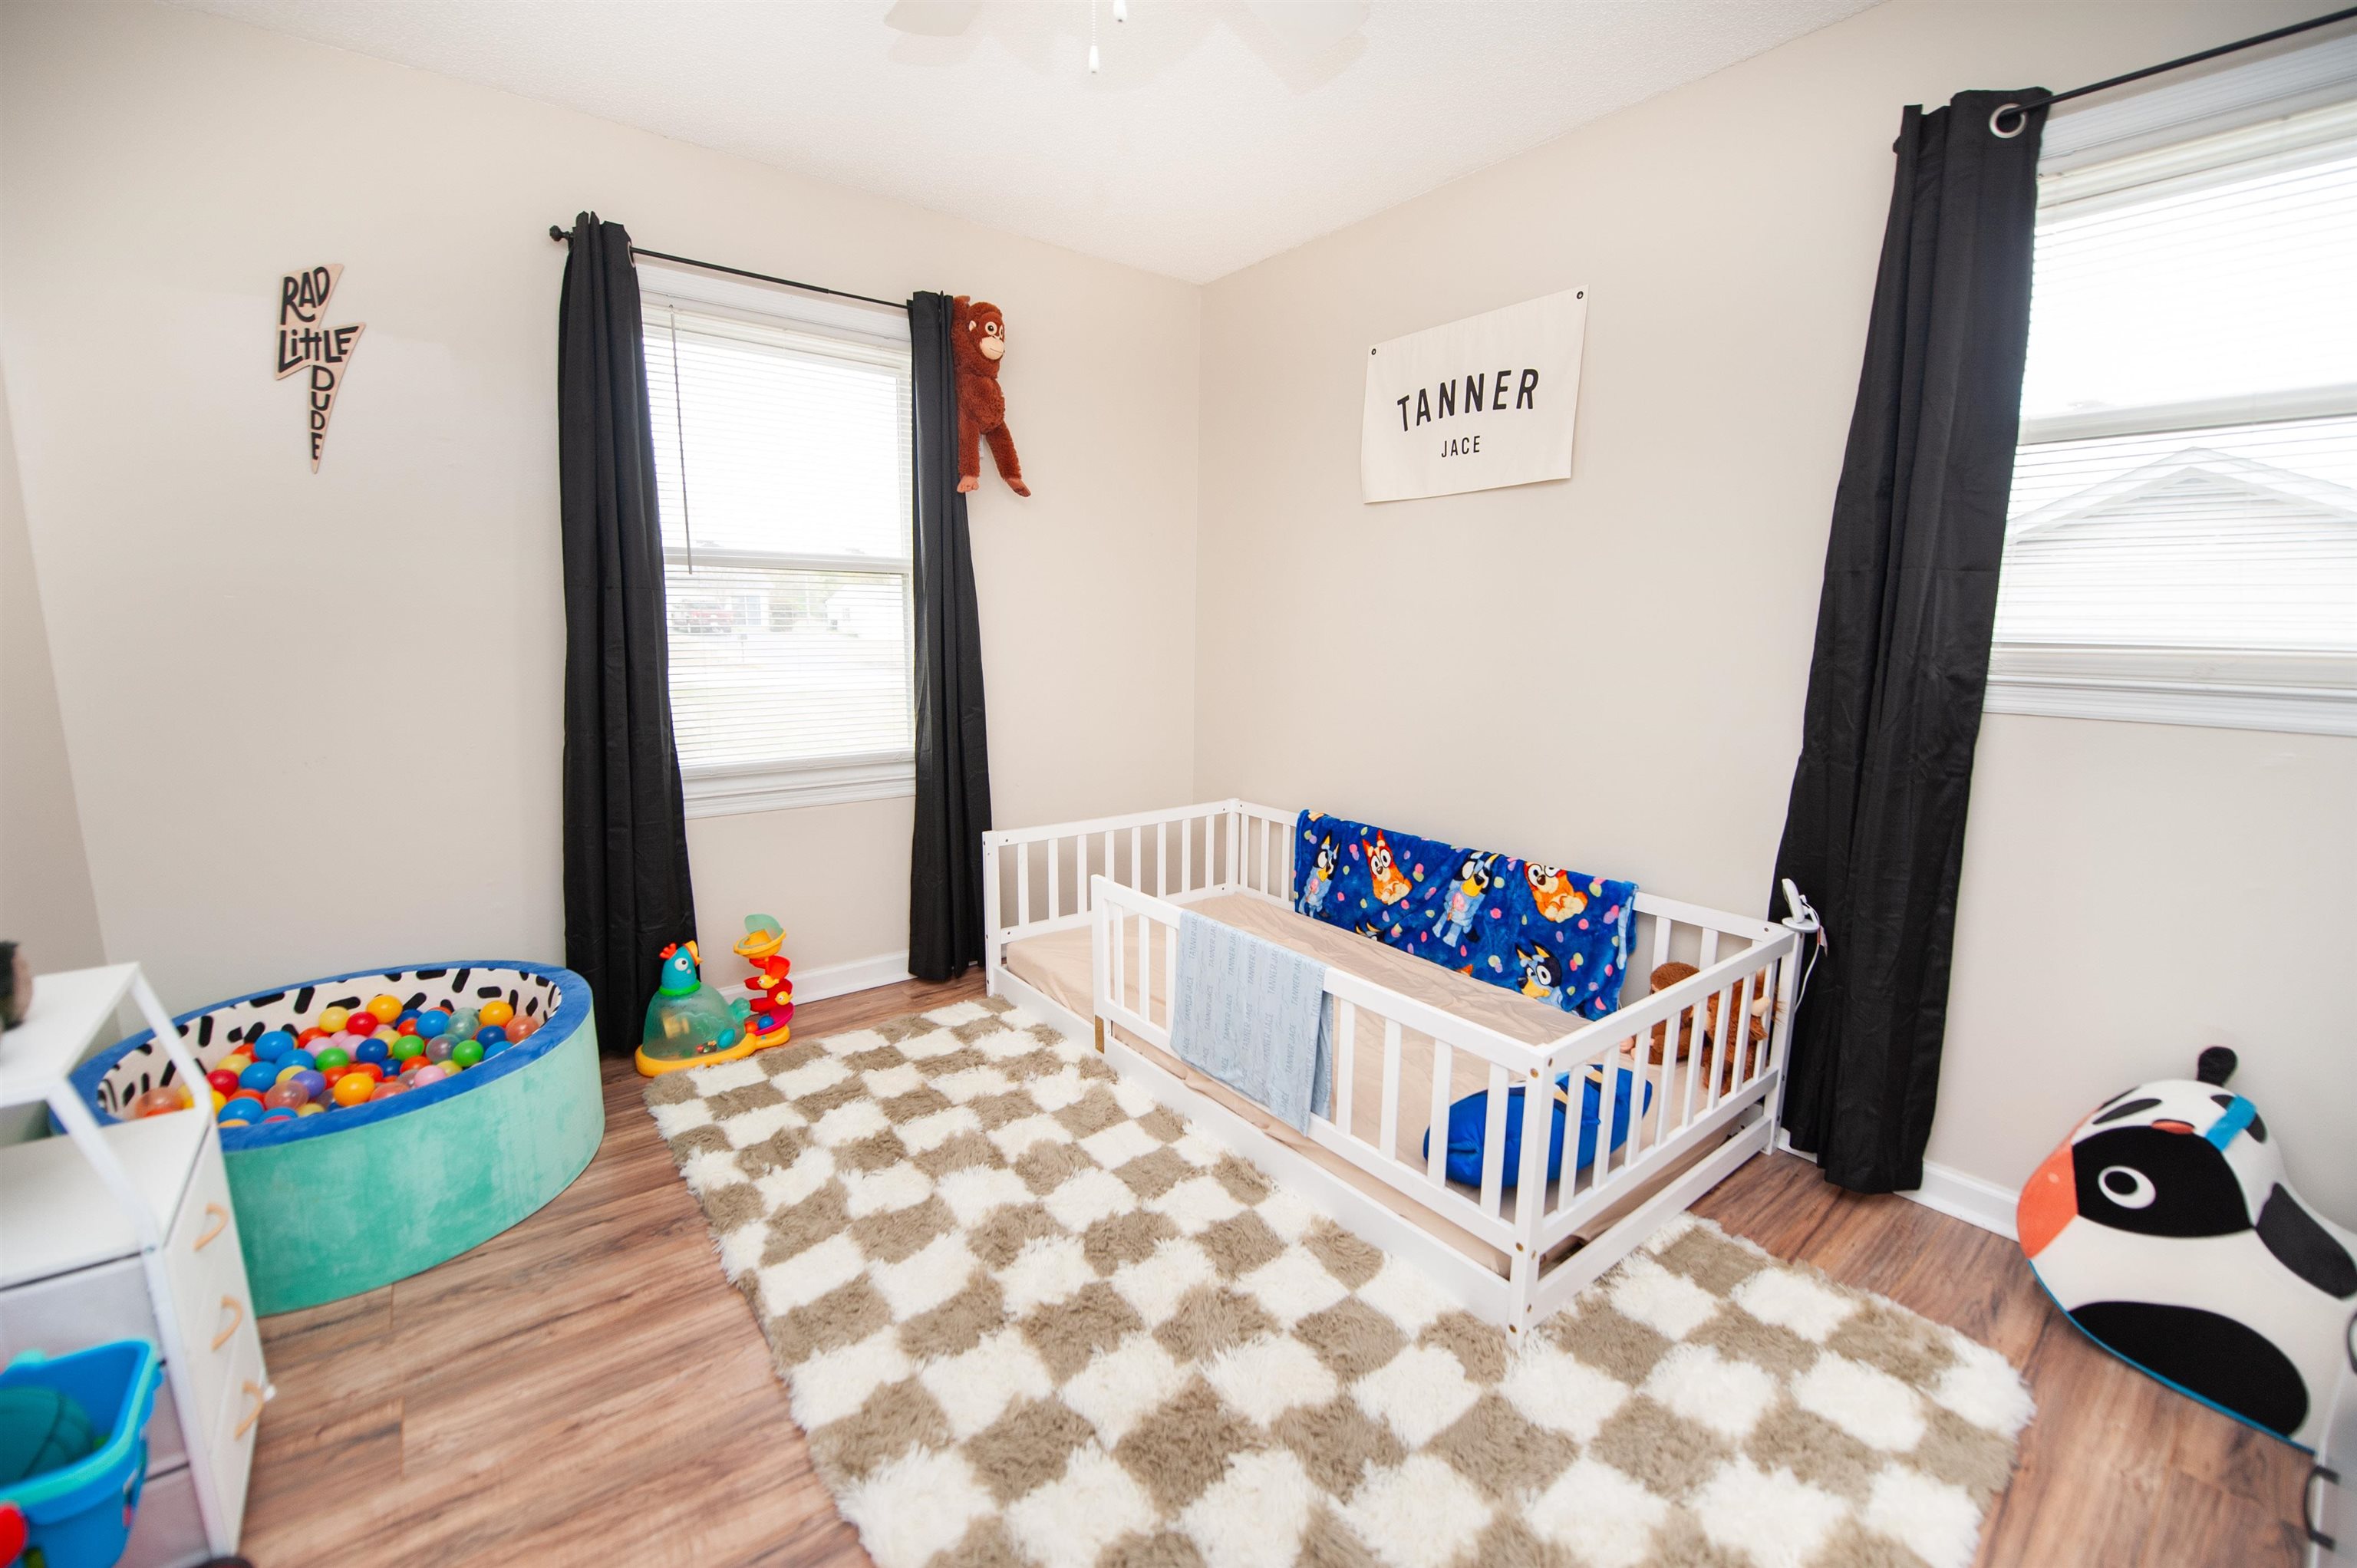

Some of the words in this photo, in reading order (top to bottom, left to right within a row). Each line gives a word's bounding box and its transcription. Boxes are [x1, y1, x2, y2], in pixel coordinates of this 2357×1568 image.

[280, 266, 330, 325] RAD
[311, 365, 335, 460] DUDE
[1396, 368, 1539, 432] TANNER
[1441, 435, 1481, 458] JACE
[1228, 946, 1236, 977] TANNER
[1247, 954, 1256, 985] TANNER
[1291, 973, 1300, 1006] TANNER
[1285, 1044, 1295, 1075] TANNER
